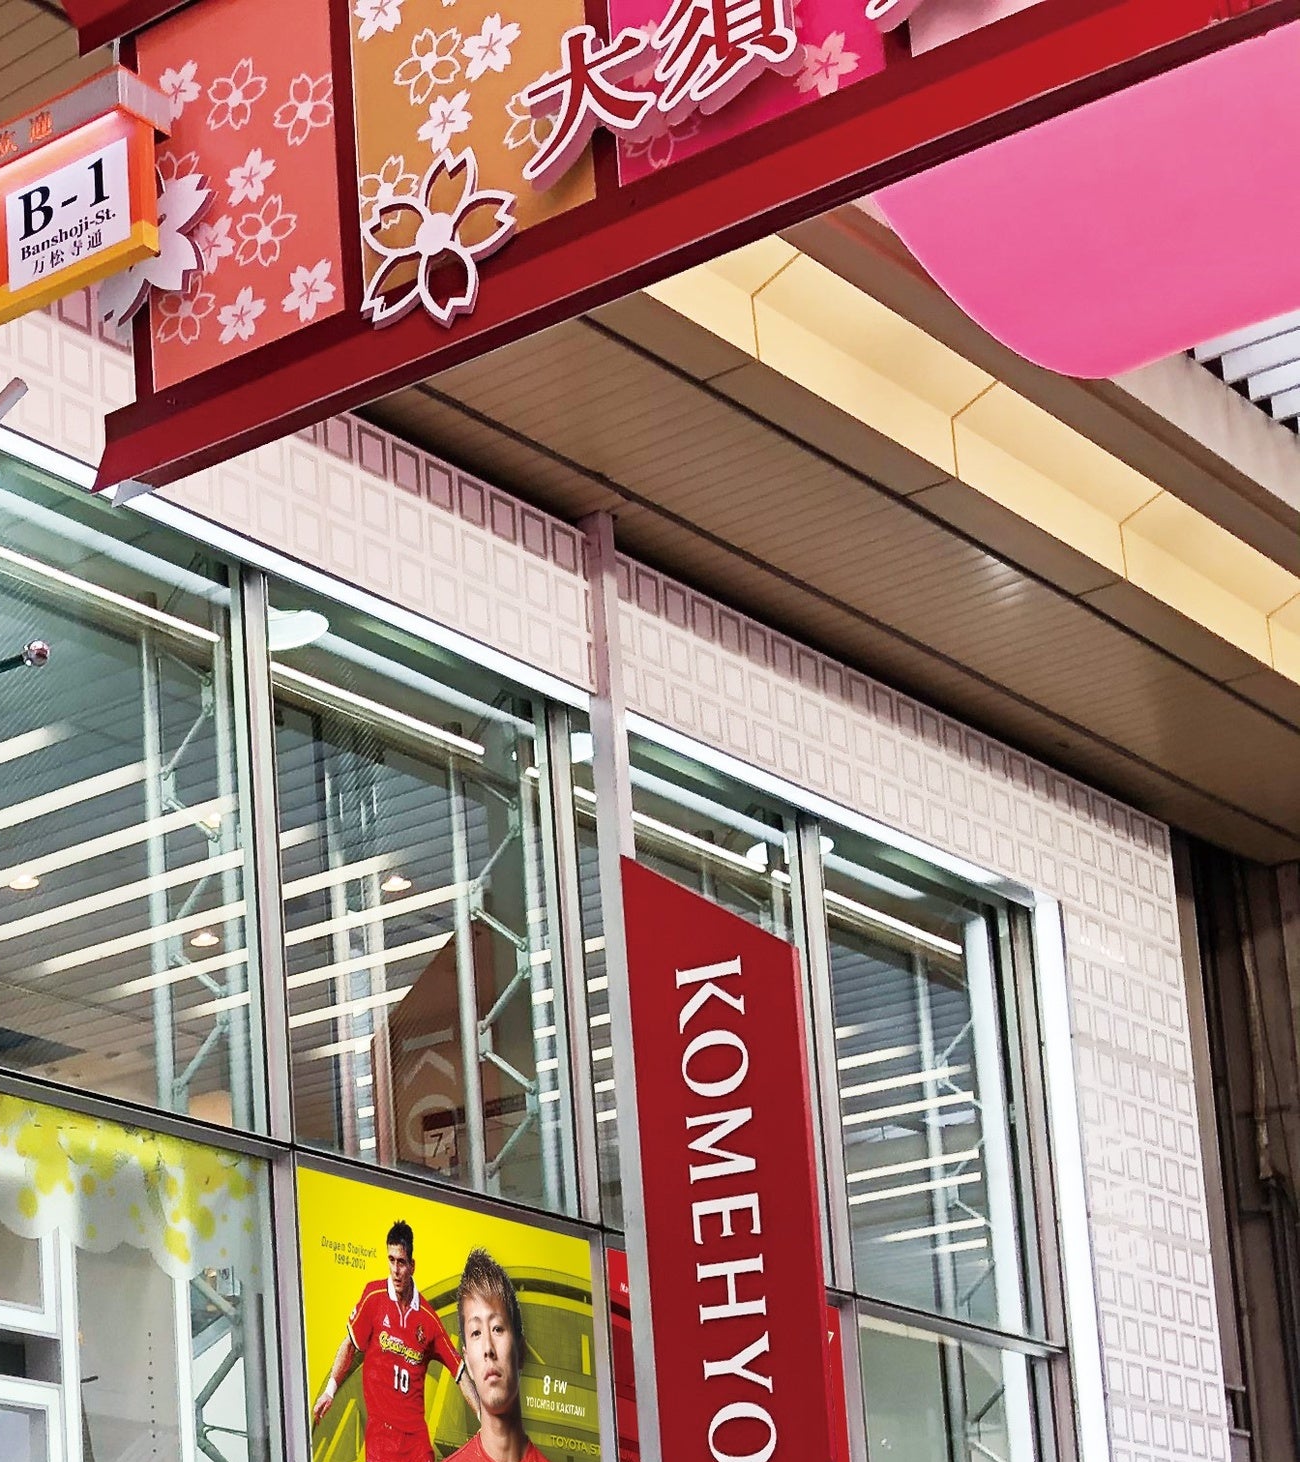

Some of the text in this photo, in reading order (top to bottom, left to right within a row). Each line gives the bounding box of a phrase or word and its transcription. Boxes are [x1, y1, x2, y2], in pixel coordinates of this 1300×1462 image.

[18, 157, 111, 241] B-1
[20, 208, 116, 262] Banshoji-St.
[32, 232, 103, 275] 万松寺通
[393, 1365, 409, 1394] 10
[543, 1375, 568, 1395] 8 FW
